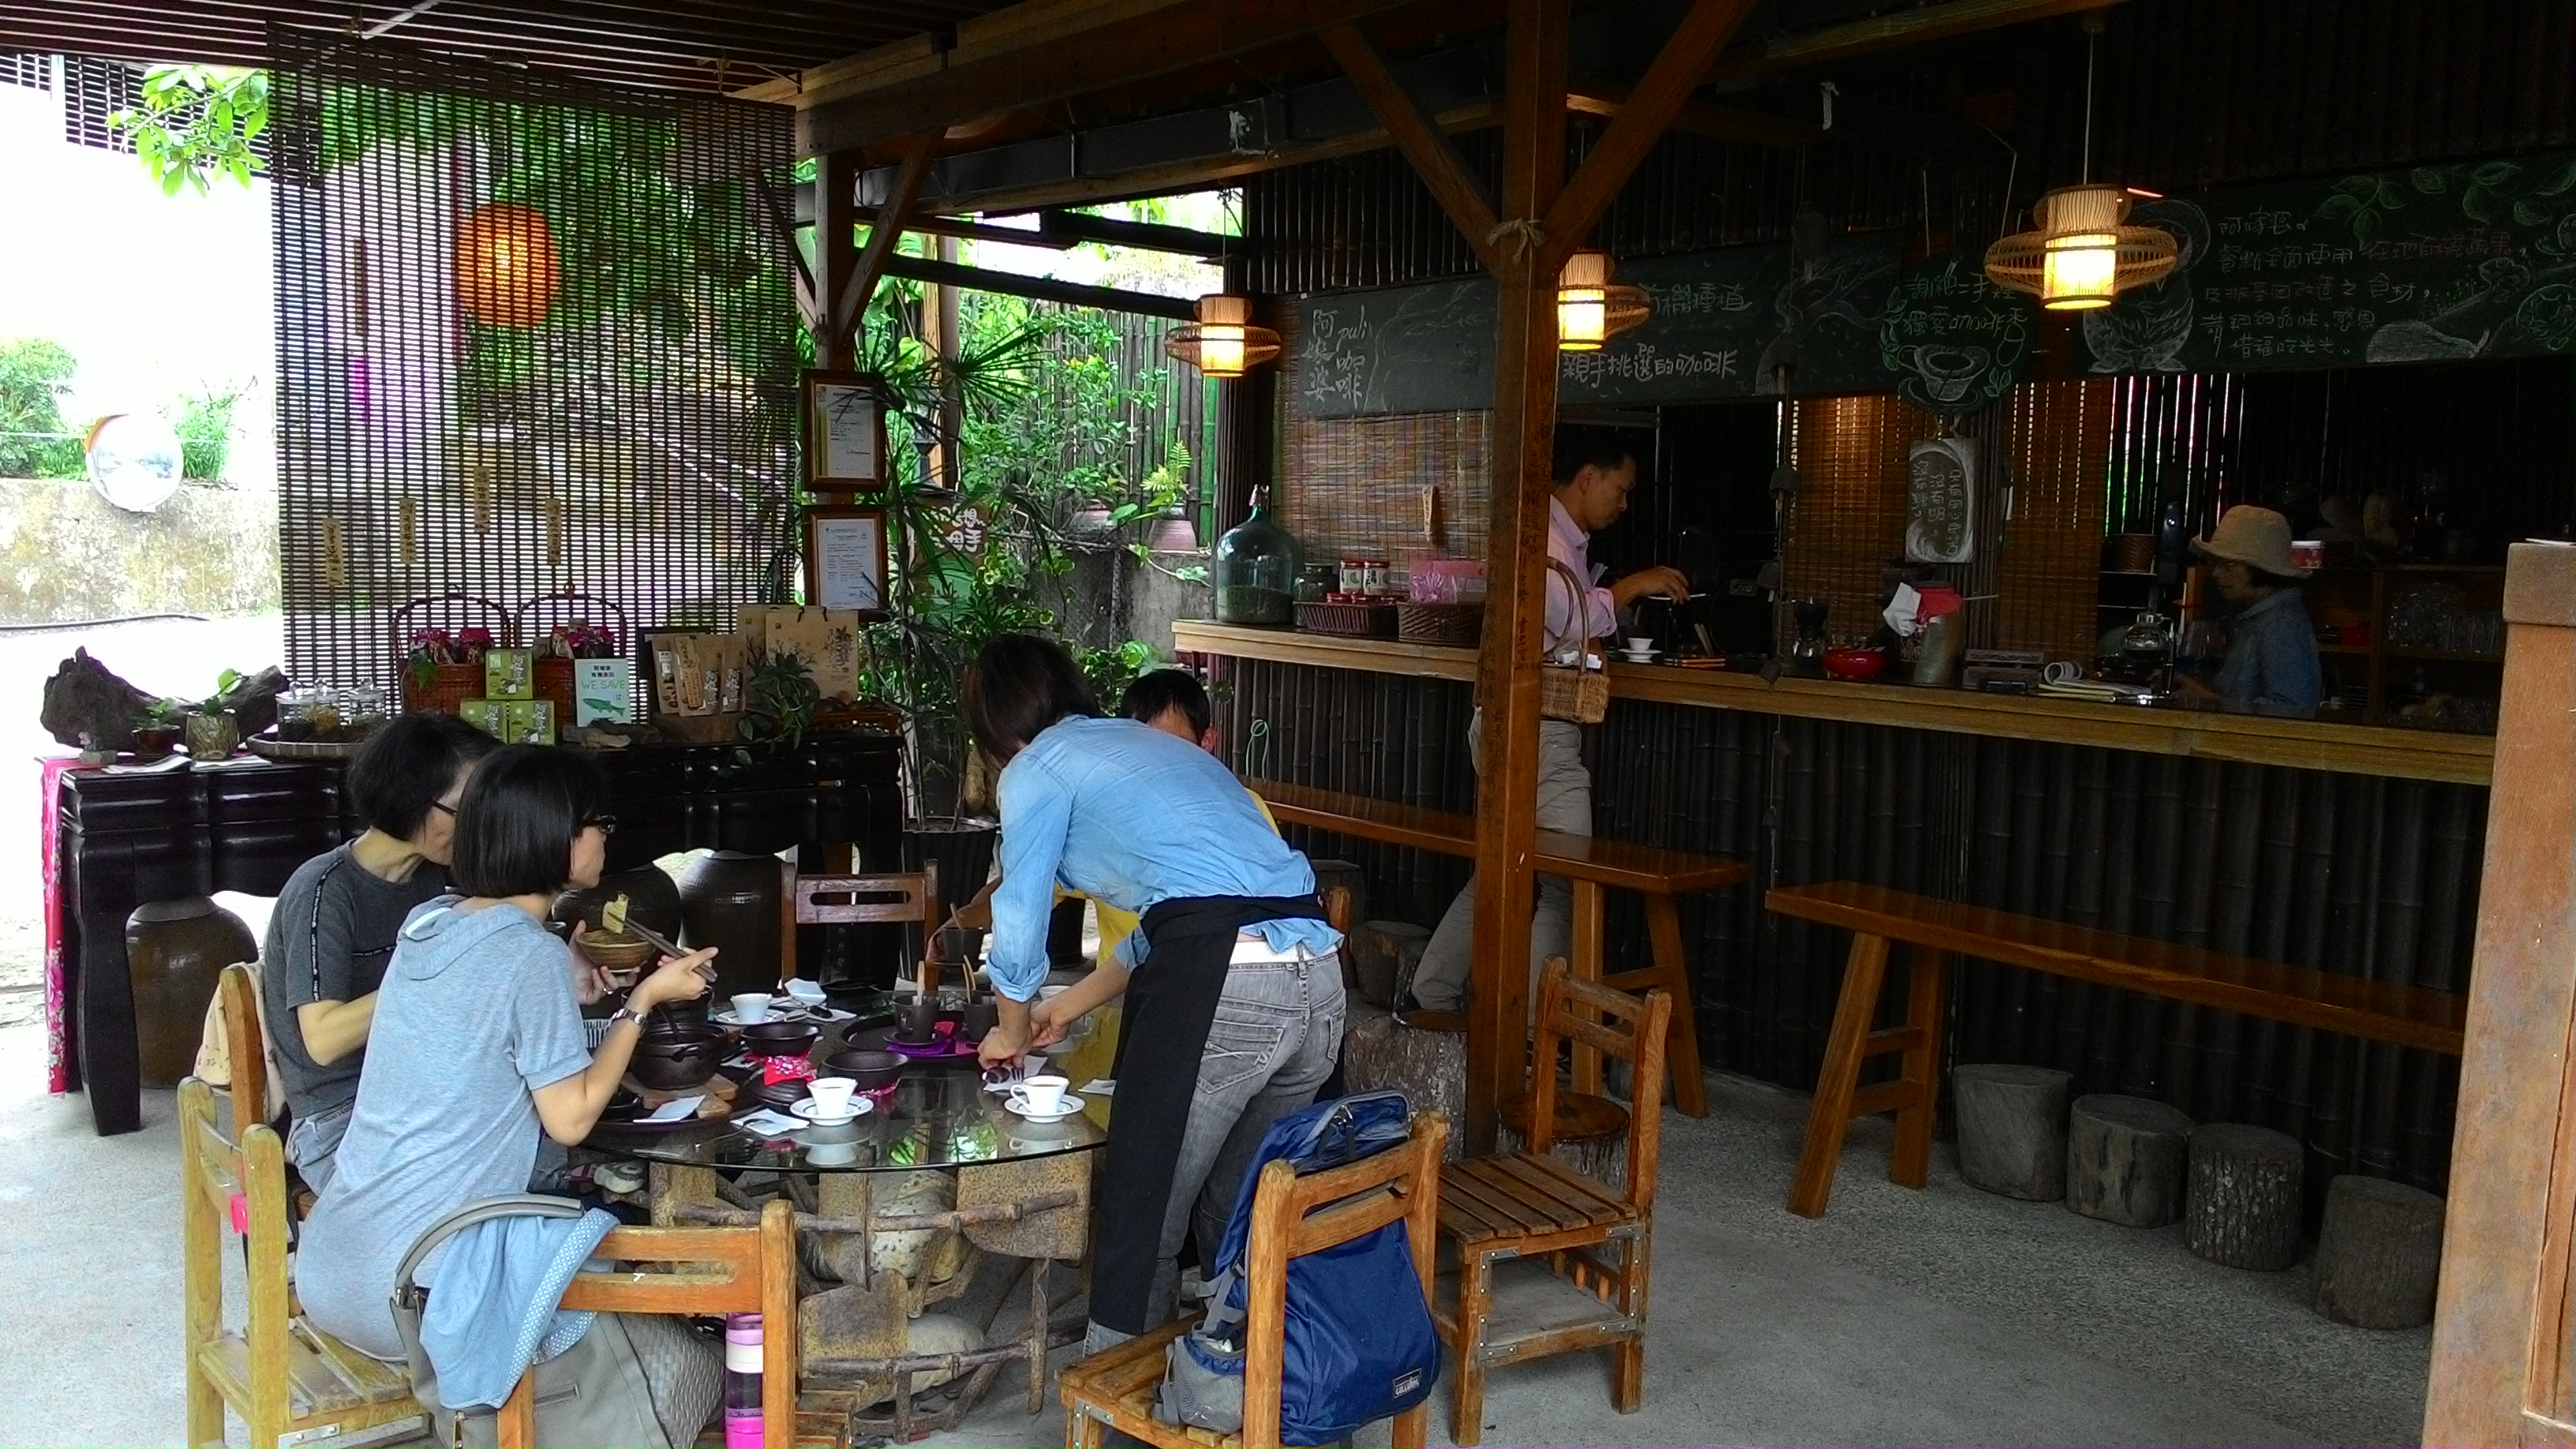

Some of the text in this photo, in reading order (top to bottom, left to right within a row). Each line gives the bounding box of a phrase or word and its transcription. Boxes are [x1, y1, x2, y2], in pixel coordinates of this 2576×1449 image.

[1335, 350, 1366, 410] 咖啡
[1562, 343, 1739, 388] 親手挑選的咖啡
[581, 680, 626, 690] WE SAVE
